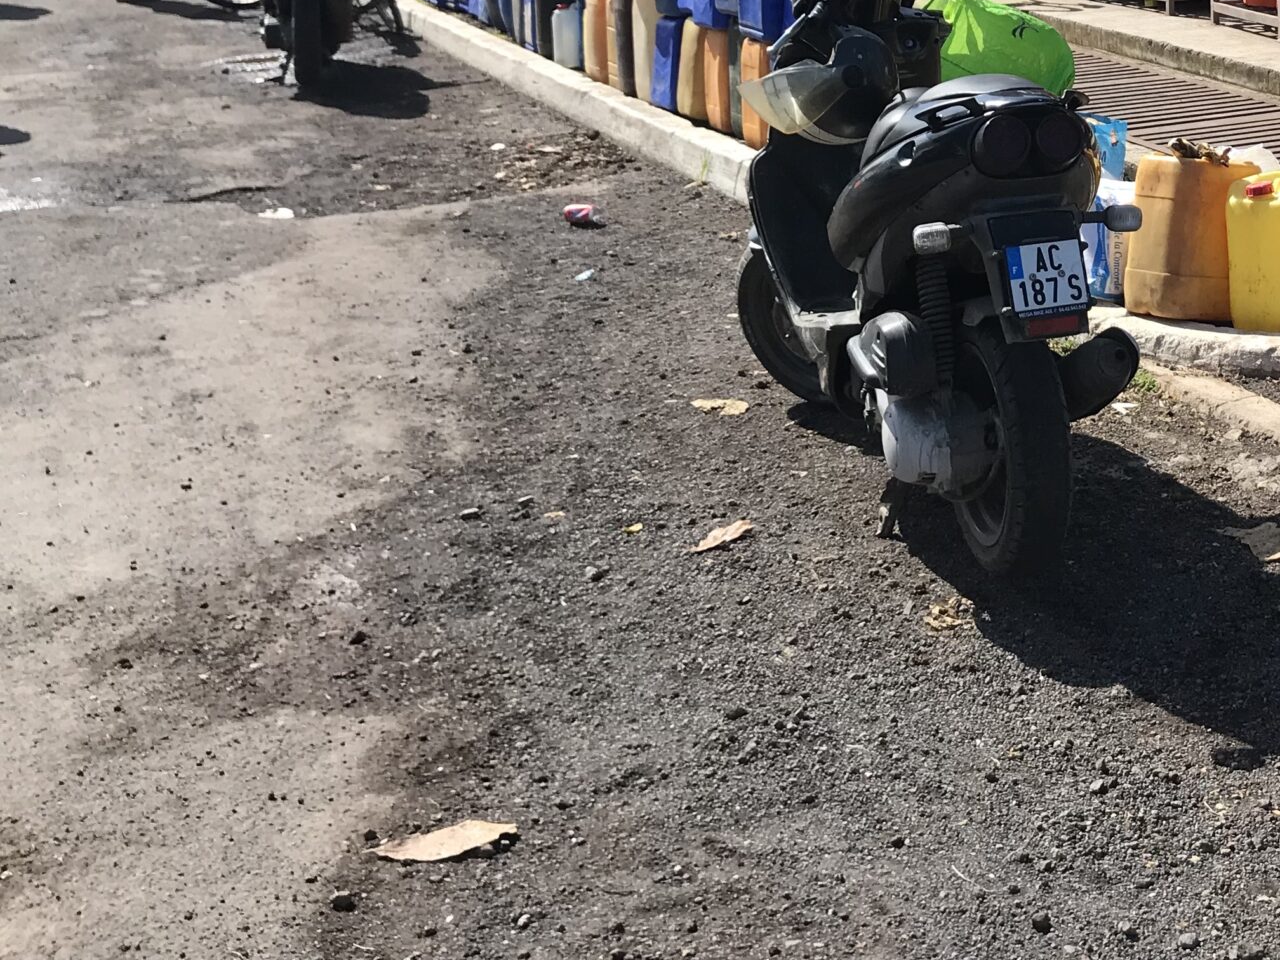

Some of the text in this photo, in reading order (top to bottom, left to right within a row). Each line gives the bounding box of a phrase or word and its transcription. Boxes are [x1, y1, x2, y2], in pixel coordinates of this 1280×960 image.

[1036, 244, 1063, 273] AC
[1113, 251, 1123, 291] Concorde
[1018, 276, 1058, 308] 187
[1067, 273, 1083, 301] S
